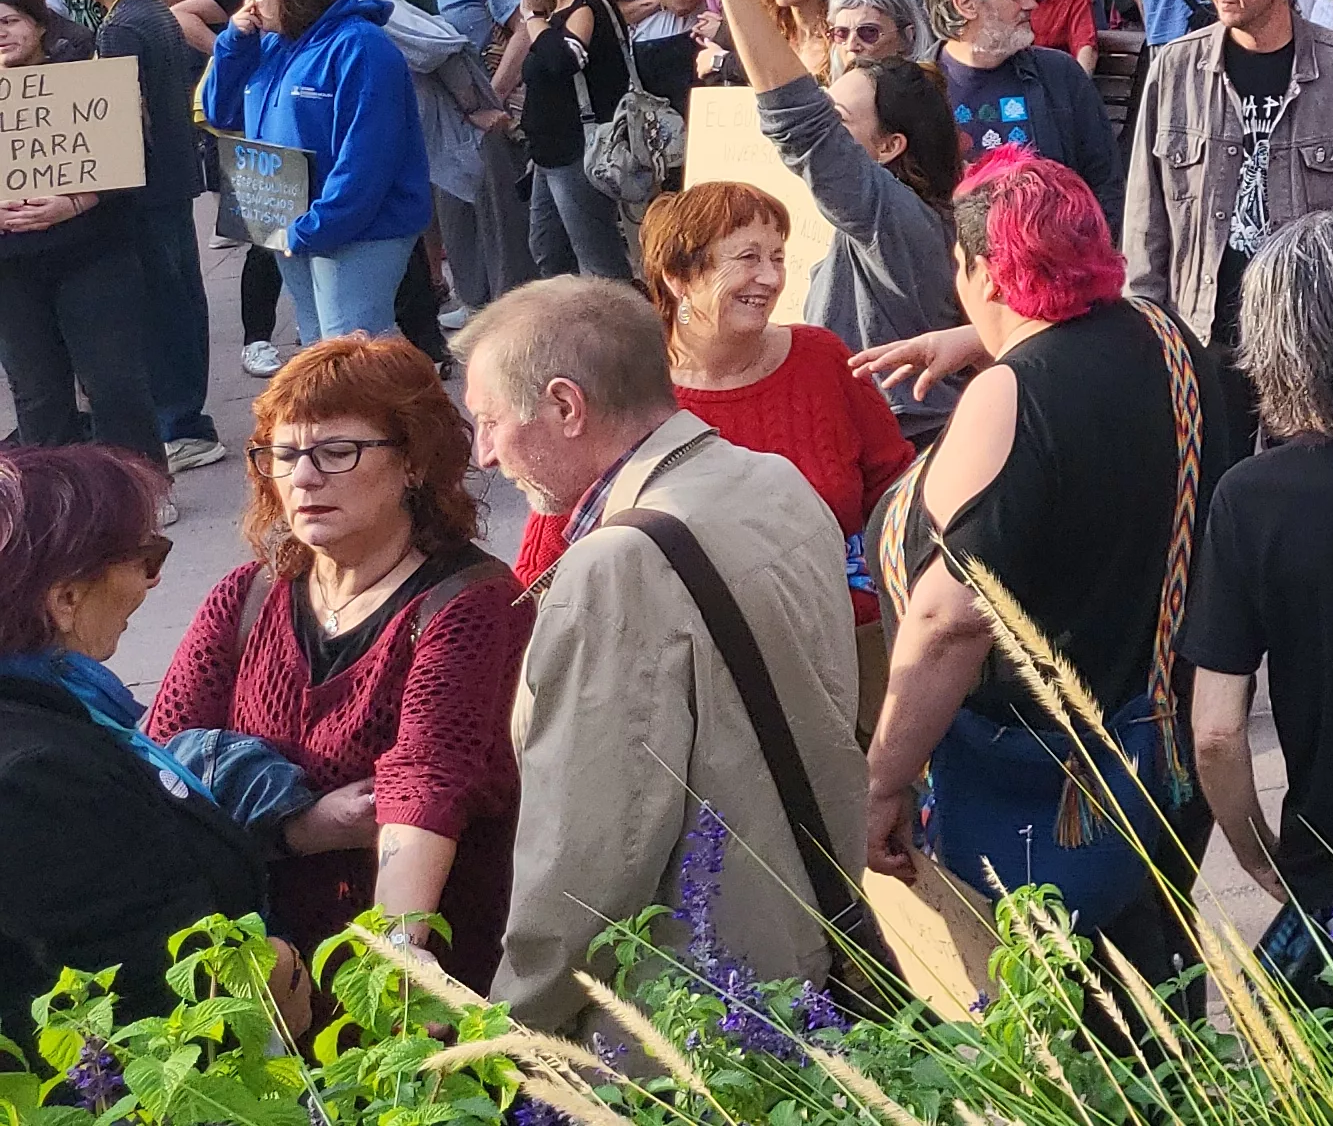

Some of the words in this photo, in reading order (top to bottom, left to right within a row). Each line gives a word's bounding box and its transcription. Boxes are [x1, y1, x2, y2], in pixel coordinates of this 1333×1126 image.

[0, 77, 12, 101] O
[22, 74, 54, 99] EL
[0, 106, 52, 132] LER
[72, 97, 108, 124] NO
[11, 132, 91, 161] PARA
[234, 145, 283, 177] STOP
[6, 159, 97, 191] OMER
